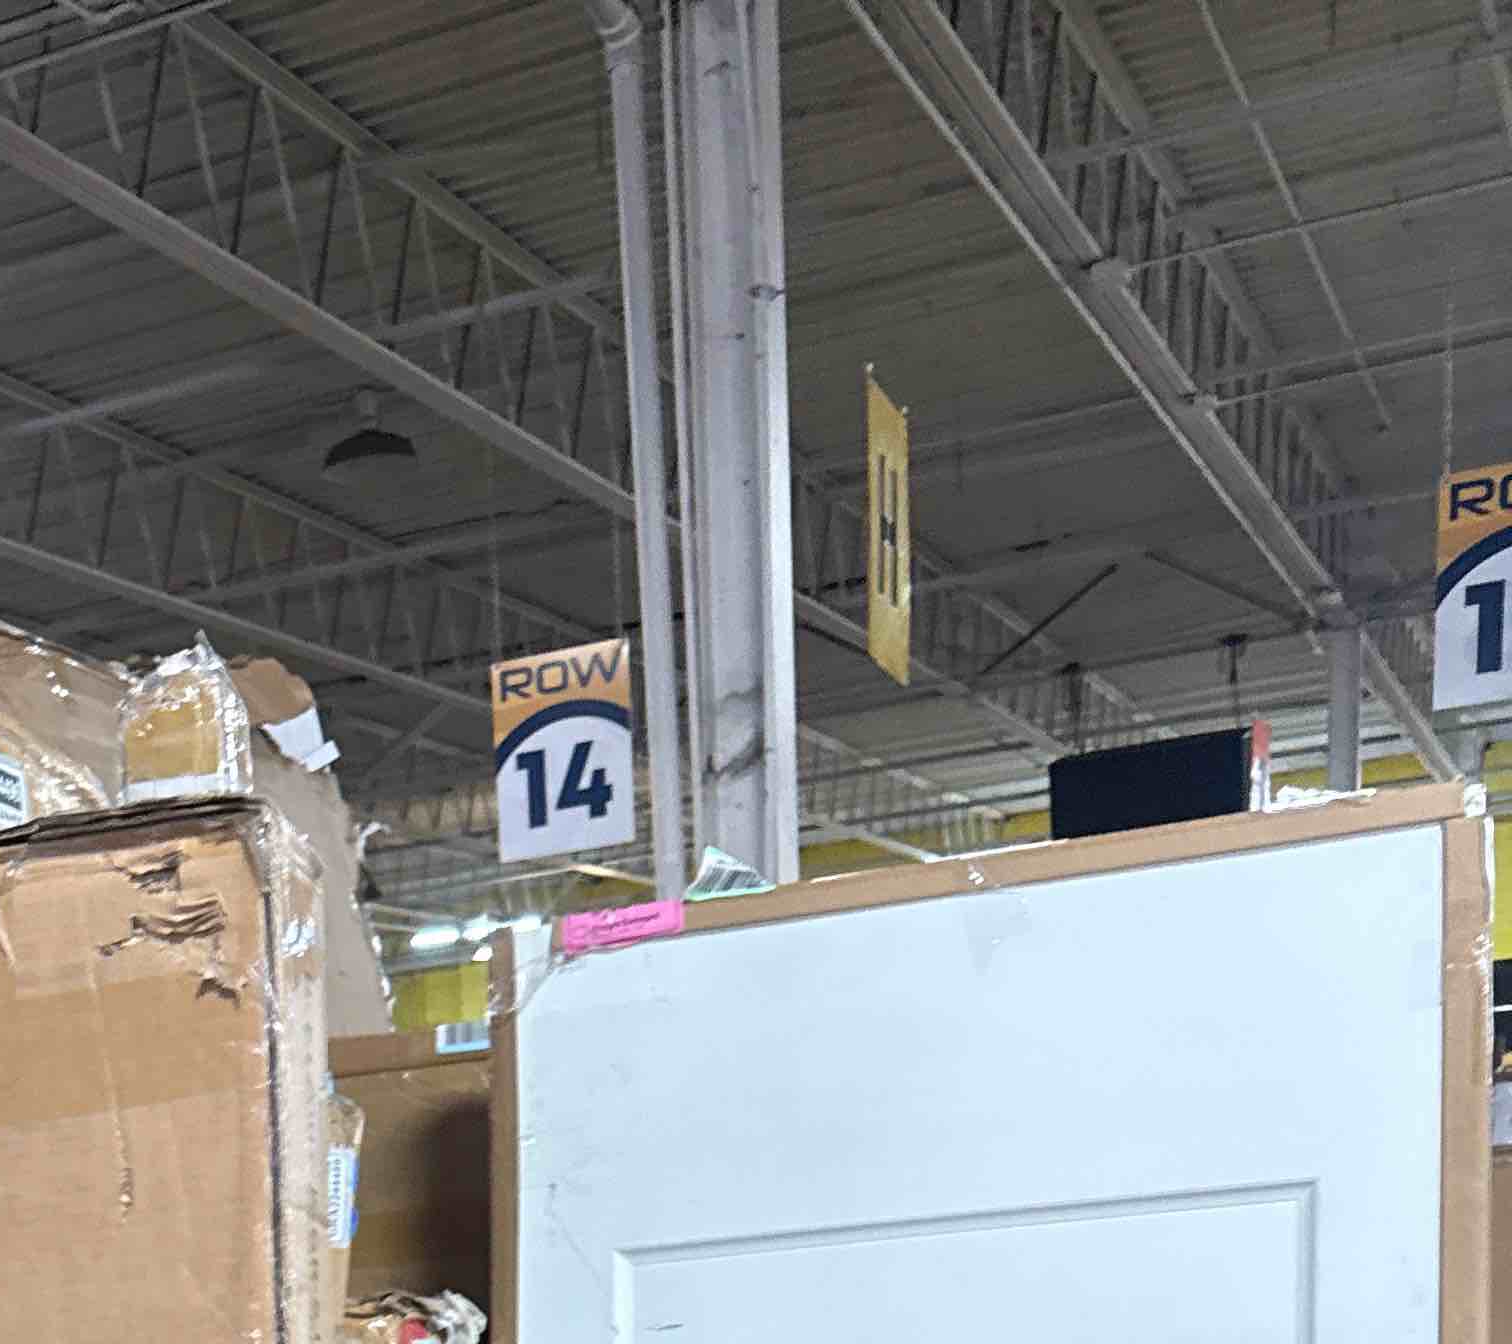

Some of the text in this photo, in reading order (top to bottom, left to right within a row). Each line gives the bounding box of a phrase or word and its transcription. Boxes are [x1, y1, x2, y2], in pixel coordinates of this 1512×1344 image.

[1449, 476, 1512, 521] R
[500, 645, 625, 702] ROW
[516, 740, 614, 829] 14
